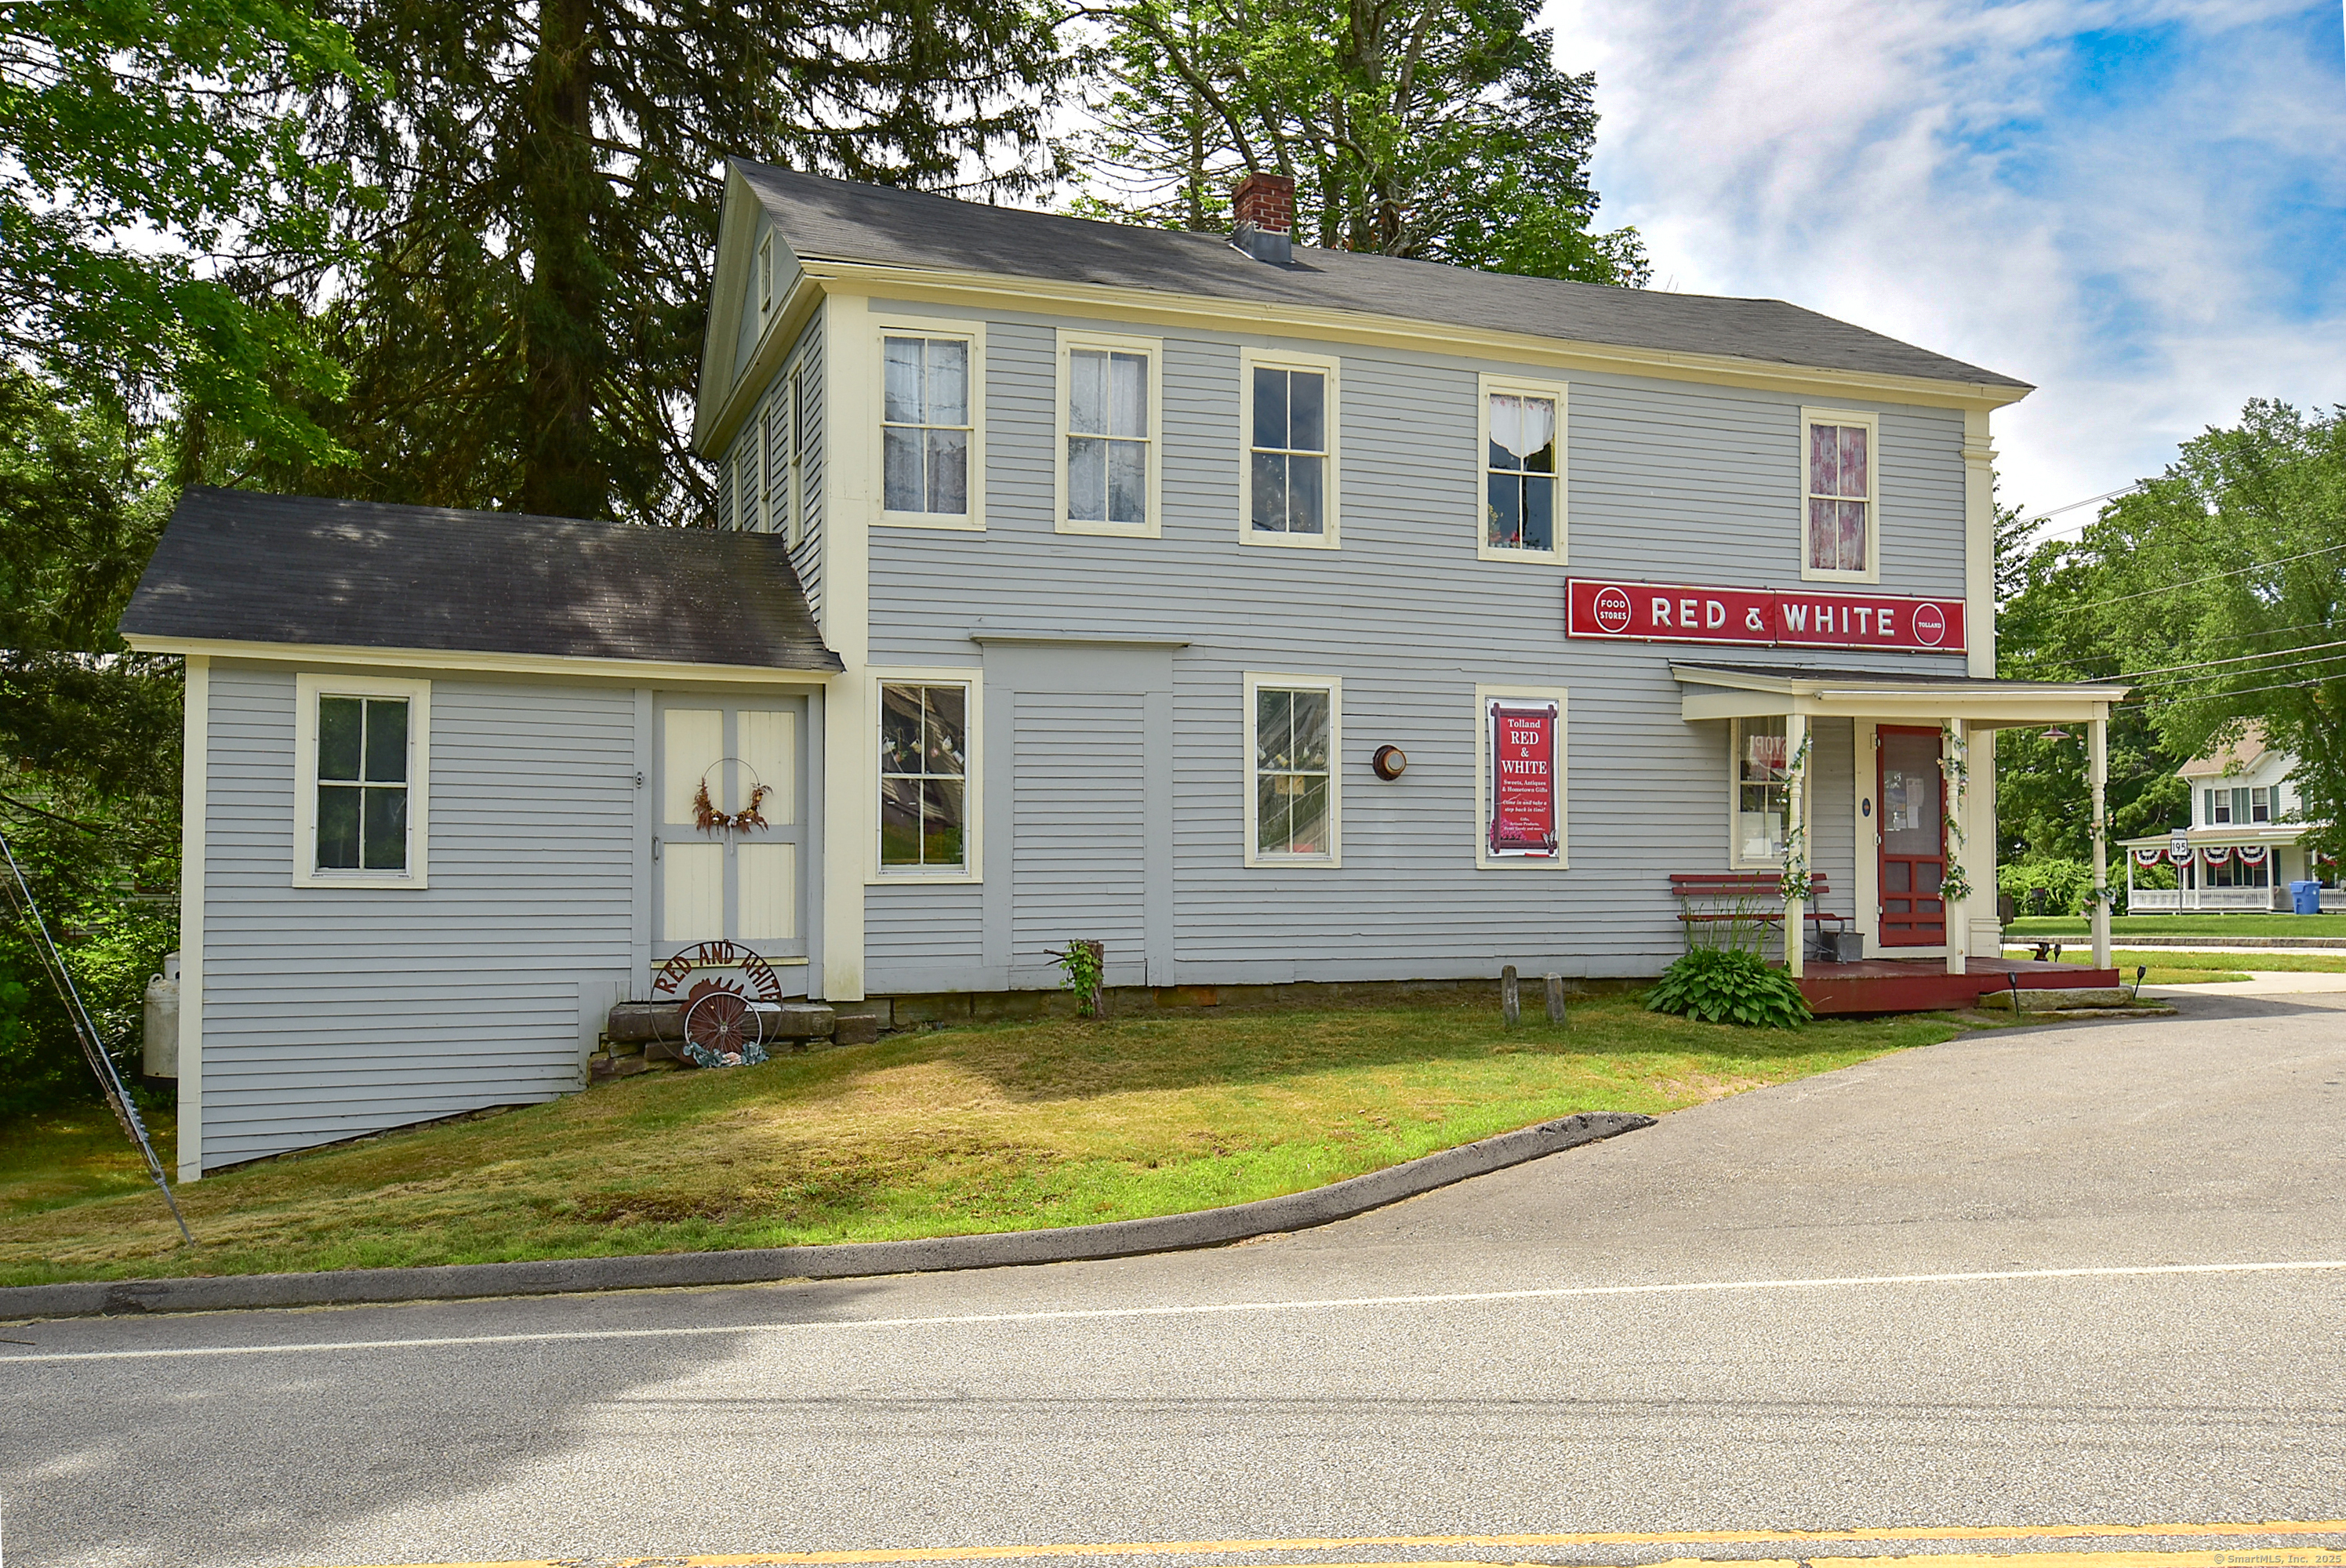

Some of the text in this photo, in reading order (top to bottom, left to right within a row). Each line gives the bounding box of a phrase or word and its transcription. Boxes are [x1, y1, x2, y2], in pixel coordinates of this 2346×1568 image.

[1600, 599, 1625, 609] FOOD
[1600, 611, 1627, 620] STORES
[1651, 597, 1895, 637] RED & WHITE
[1508, 718, 1541, 728] Tolland
[1510, 731, 1539, 745] RED
[1520, 746, 1529, 757] &
[1501, 760, 1547, 775] WHITE
[2173, 842, 2185, 852] 195
[655, 942, 782, 1004] RED AND WHITE
